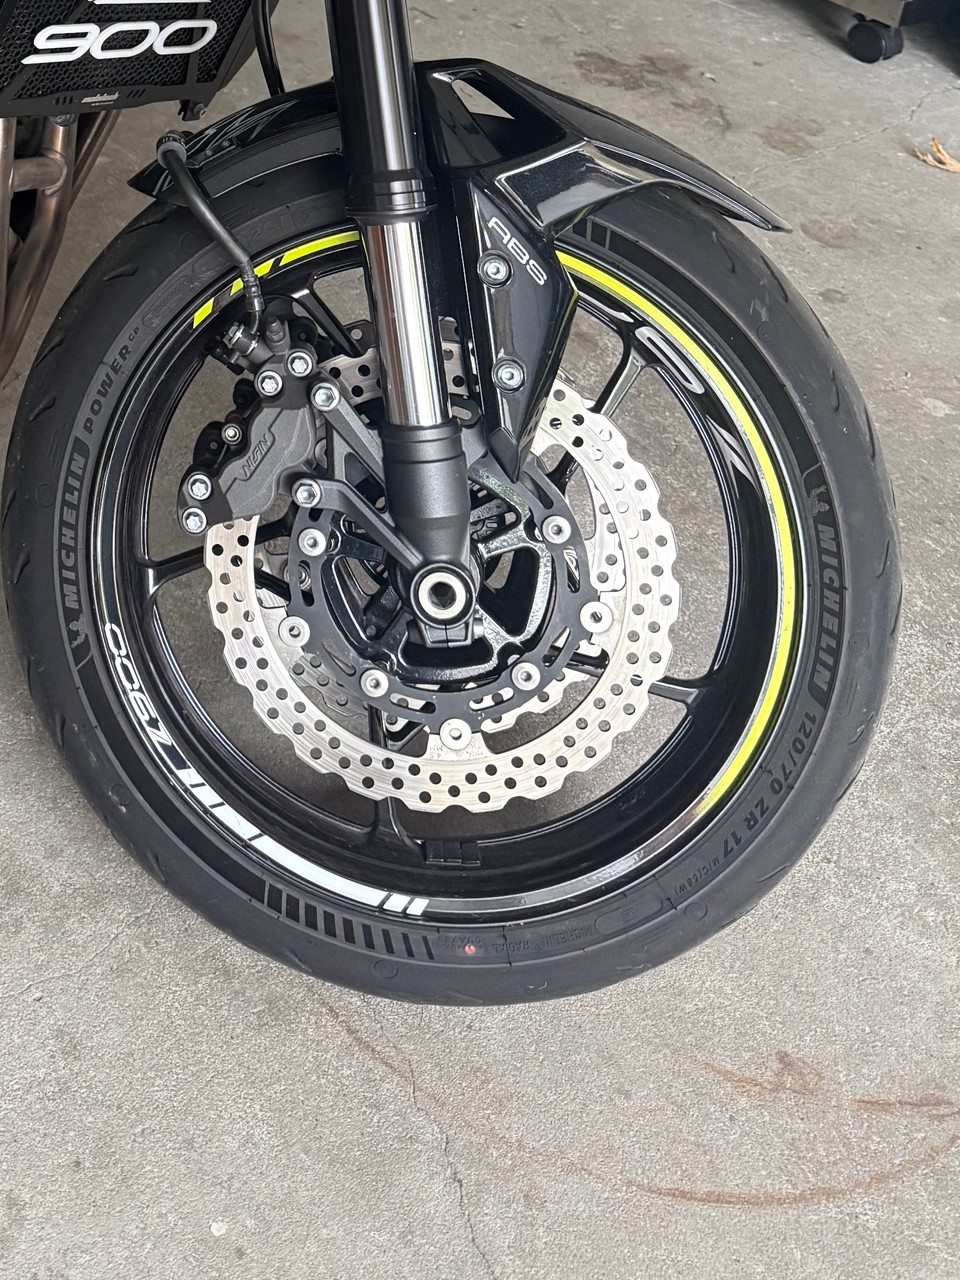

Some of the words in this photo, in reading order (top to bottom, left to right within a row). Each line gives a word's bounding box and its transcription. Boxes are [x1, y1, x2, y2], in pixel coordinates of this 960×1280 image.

[20, 19, 218, 65] 900
[487, 216, 548, 286] ABS
[61, 452, 86, 610] MICHELIN
[83, 344, 132, 435] POWER
[813, 523, 840, 692] MICHELIN
[104, 622, 172, 746] Z900
[769, 711, 817, 795] 120/70
[723, 830, 743, 859] 17
[744, 795, 770, 831] ZR
